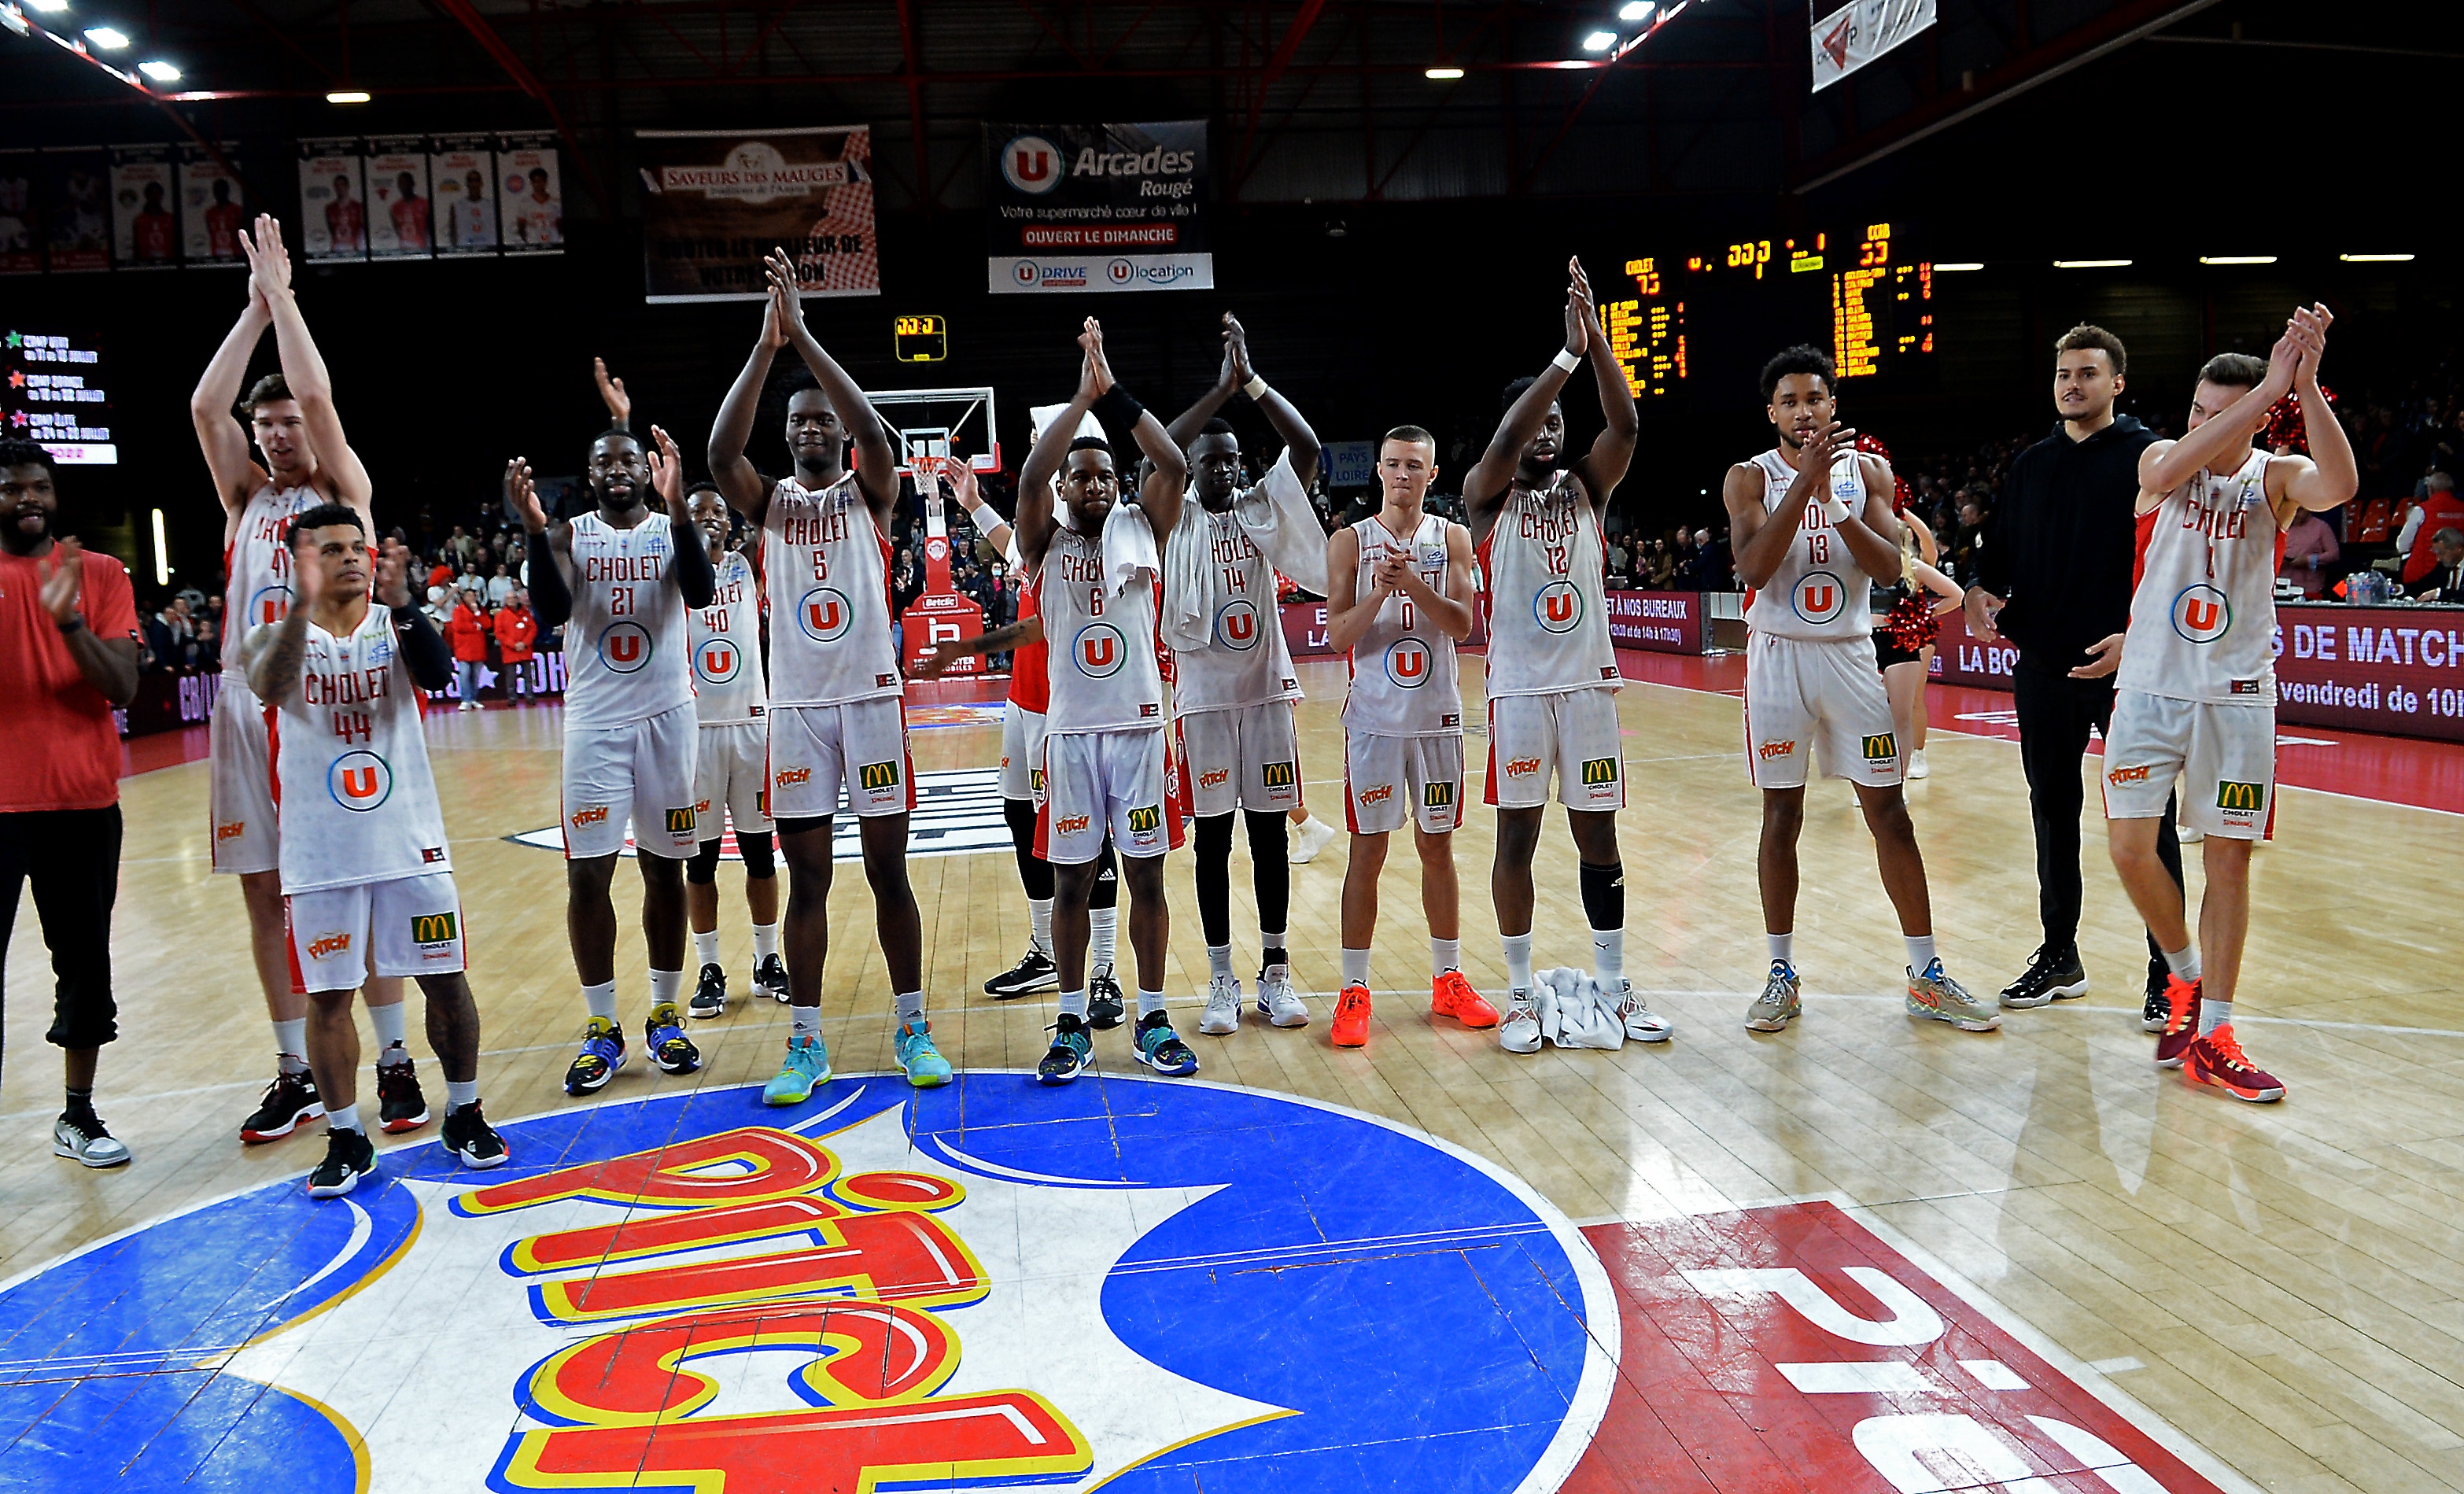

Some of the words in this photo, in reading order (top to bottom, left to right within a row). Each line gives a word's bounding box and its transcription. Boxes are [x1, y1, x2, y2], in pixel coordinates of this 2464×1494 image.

[668, 168, 740, 186] SAVEURS
[744, 170, 769, 183] DES
[773, 165, 844, 184] MAUGES
[1073, 146, 1194, 176] Arcades
[1141, 179, 1193, 197] Rougé
[1000, 205, 1033, 219] Votre
[1036, 205, 1111, 220] supermarché
[1151, 205, 1167, 217] de
[1170, 204, 1190, 216] ville
[841, 234, 862, 253] DE
[1026, 230, 1080, 243] OUVERT
[1085, 230, 1100, 243] LE
[1104, 228, 1174, 243] DIMANCHE
[1042, 266, 1087, 279] DRIVE
[1136, 261, 1194, 279] location
[1339, 452, 1368, 463] PAYS
[1336, 469, 1369, 481] LOIRE
[784, 512, 849, 545] CHOLET
[1520, 506, 1579, 543] CHOLET
[1544, 545, 1569, 575] 12
[1807, 534, 1829, 565] 13
[586, 555, 661, 583] CHOLET
[813, 550, 827, 581] 5
[1062, 553, 1105, 584] CHO
[1222, 566, 1245, 596] 14
[611, 587, 635, 616] 21
[1090, 587, 1104, 617] 6
[1617, 593, 1623, 615] À
[1624, 599, 1642, 617] NOS
[1643, 599, 1687, 620] BUREAUX
[704, 608, 729, 633] 40
[1402, 602, 1415, 632] 0
[2294, 624, 2337, 661] DE
[1959, 644, 1984, 673] LA
[1988, 647, 2020, 676] BO
[305, 665, 388, 706] CHOLET
[2280, 680, 2381, 710] vendredi
[2387, 684, 2418, 714] de
[334, 710, 372, 745] 44
[2222, 809, 2255, 817] CHOLET
